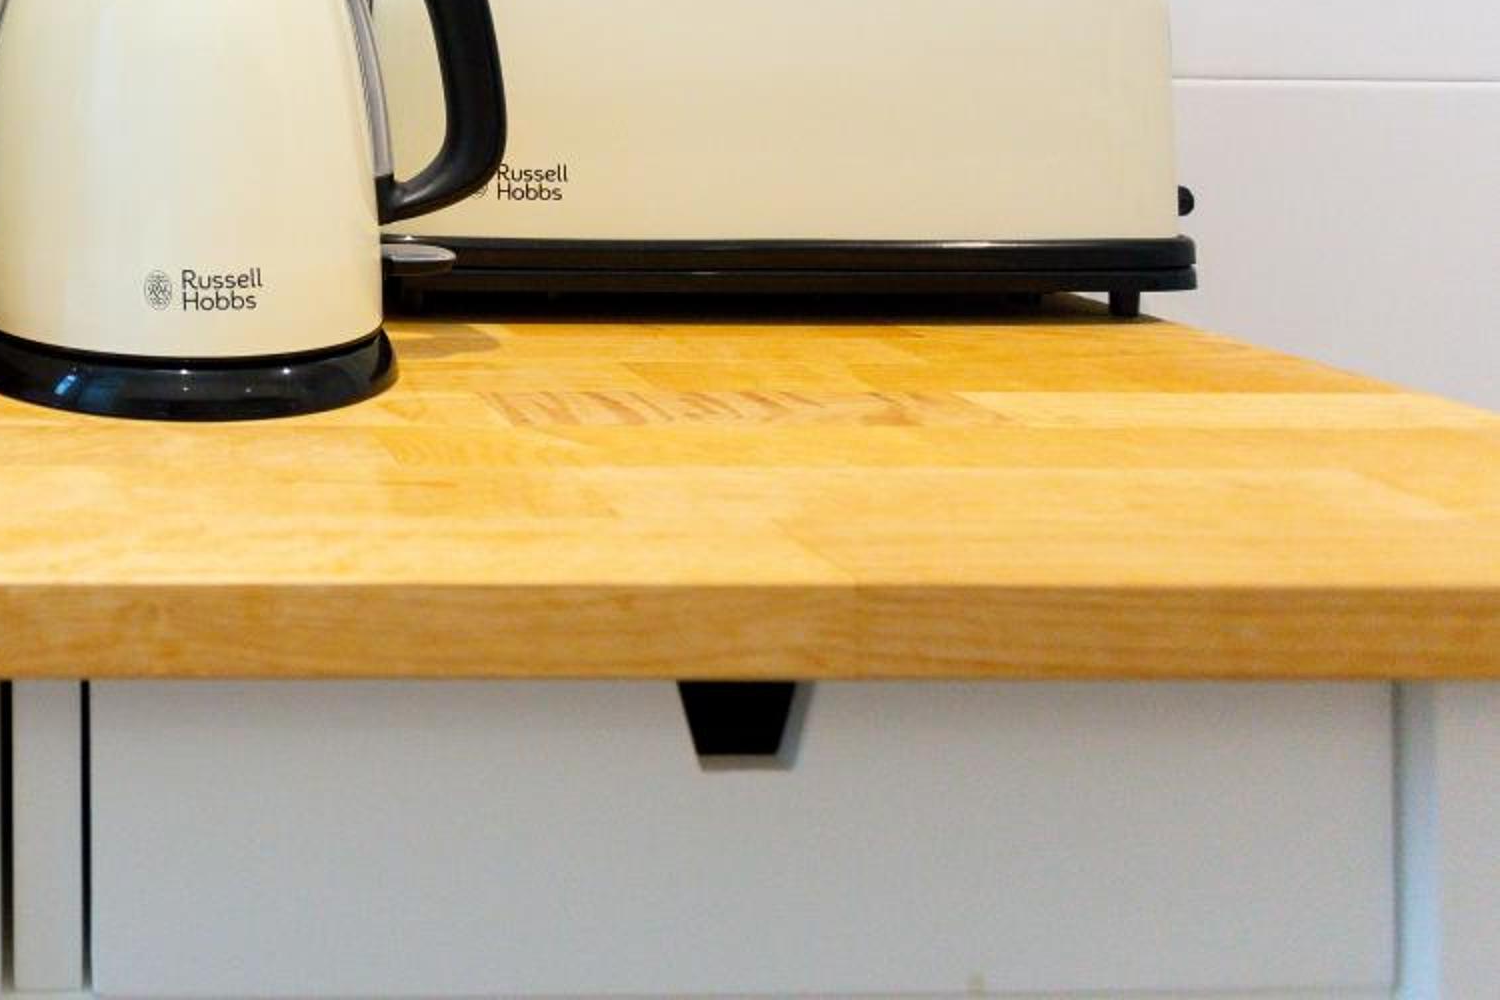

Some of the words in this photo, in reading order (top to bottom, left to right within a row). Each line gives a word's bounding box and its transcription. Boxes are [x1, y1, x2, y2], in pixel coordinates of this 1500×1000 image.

[498, 163, 568, 182] Russell
[498, 183, 563, 201] Hobbs
[182, 267, 263, 290] Russell
[183, 290, 258, 311] Hobbs
